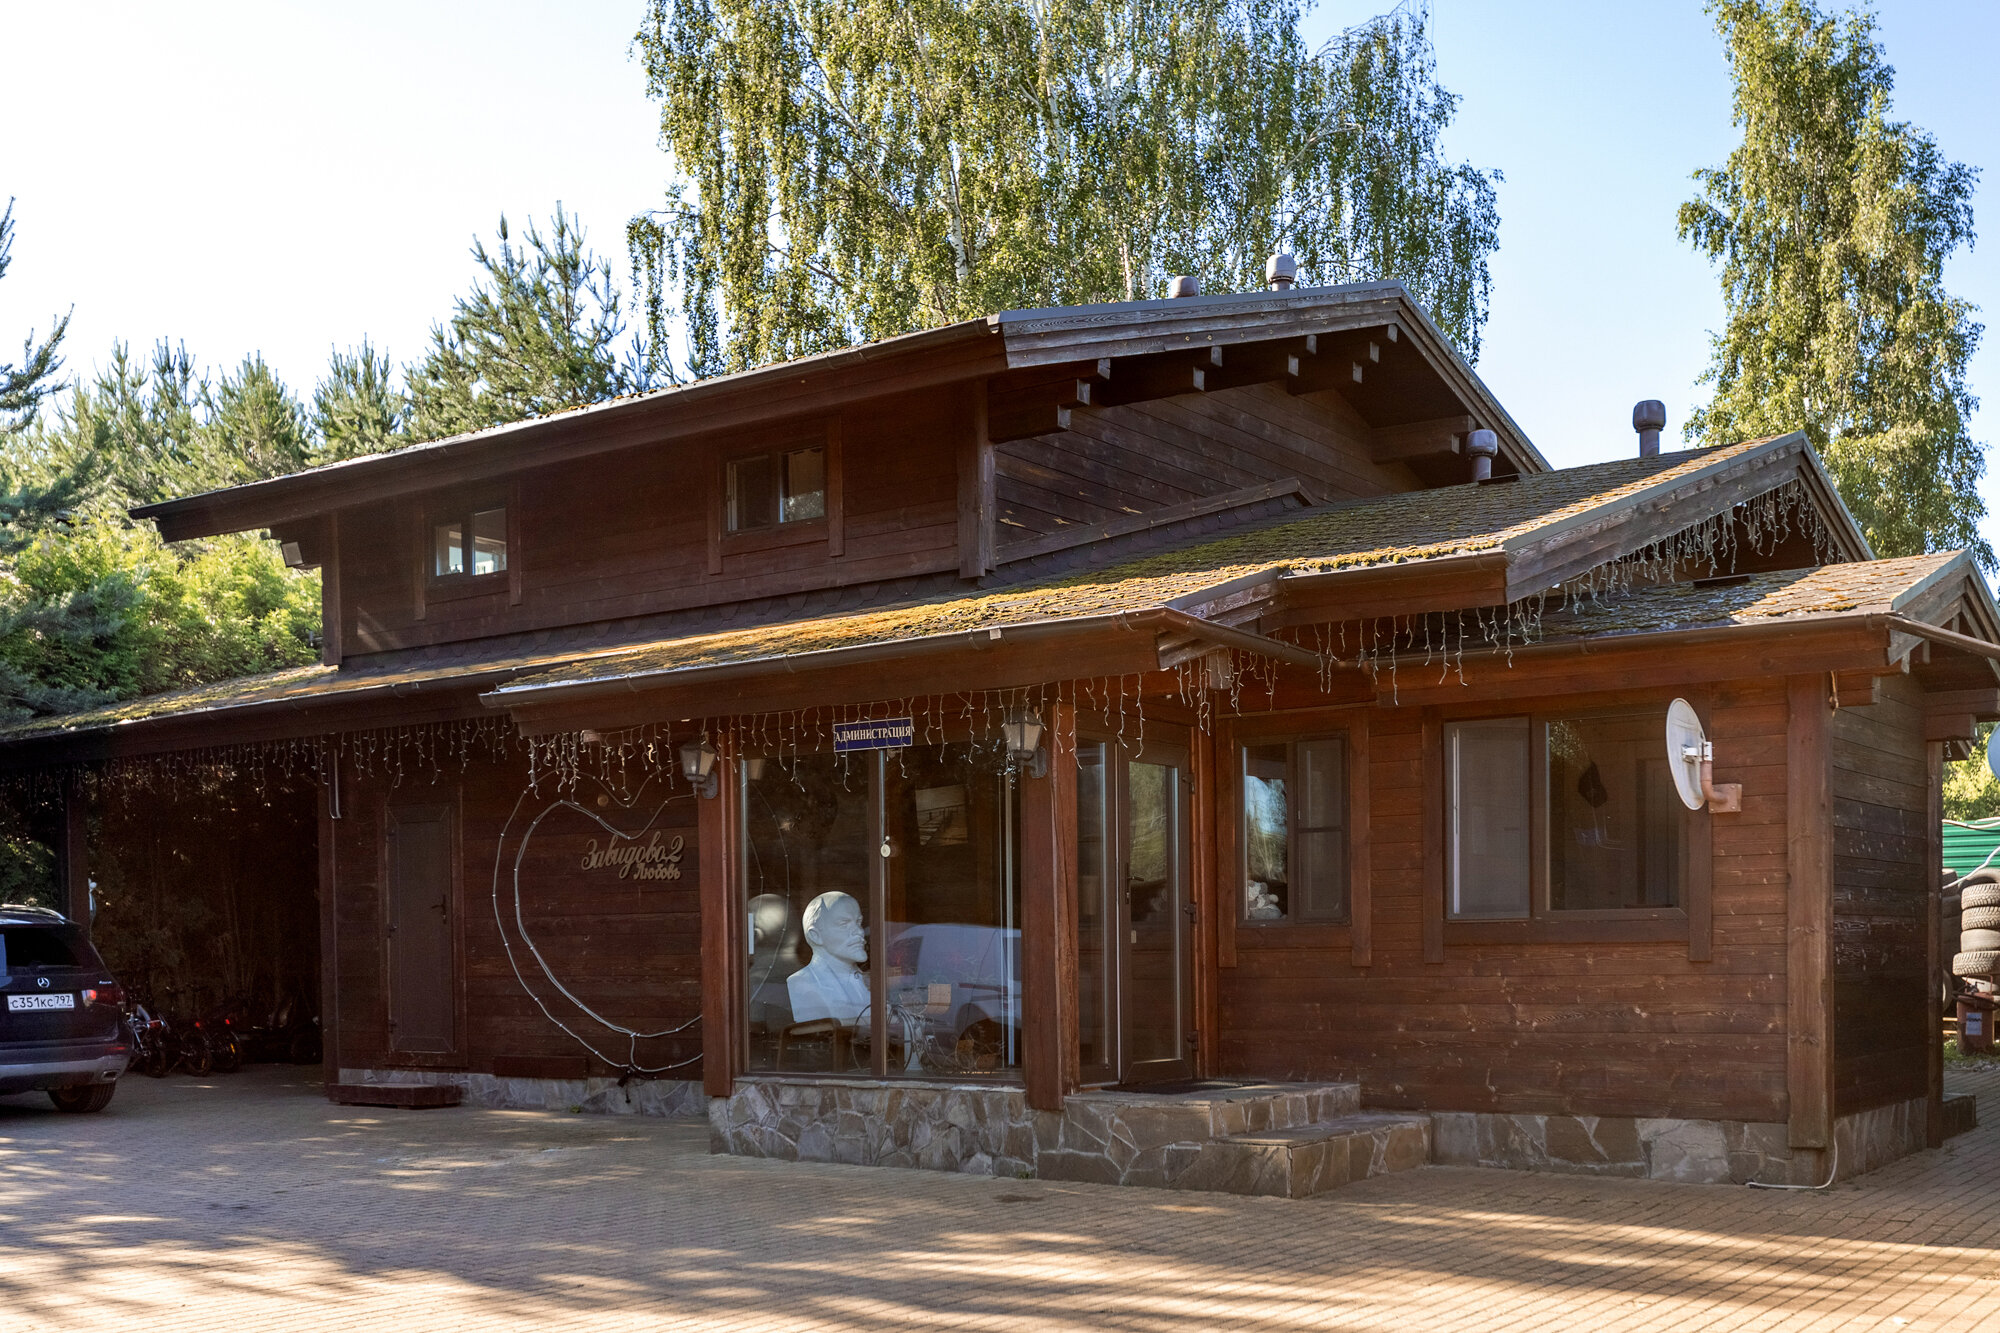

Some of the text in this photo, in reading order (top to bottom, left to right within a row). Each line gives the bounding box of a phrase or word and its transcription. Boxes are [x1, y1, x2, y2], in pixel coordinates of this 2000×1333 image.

[835, 726, 911, 743] АДМИНИСТРАЦИЯ
[582, 831, 666, 879] Завидово
[633, 863, 681, 880] Любовь
